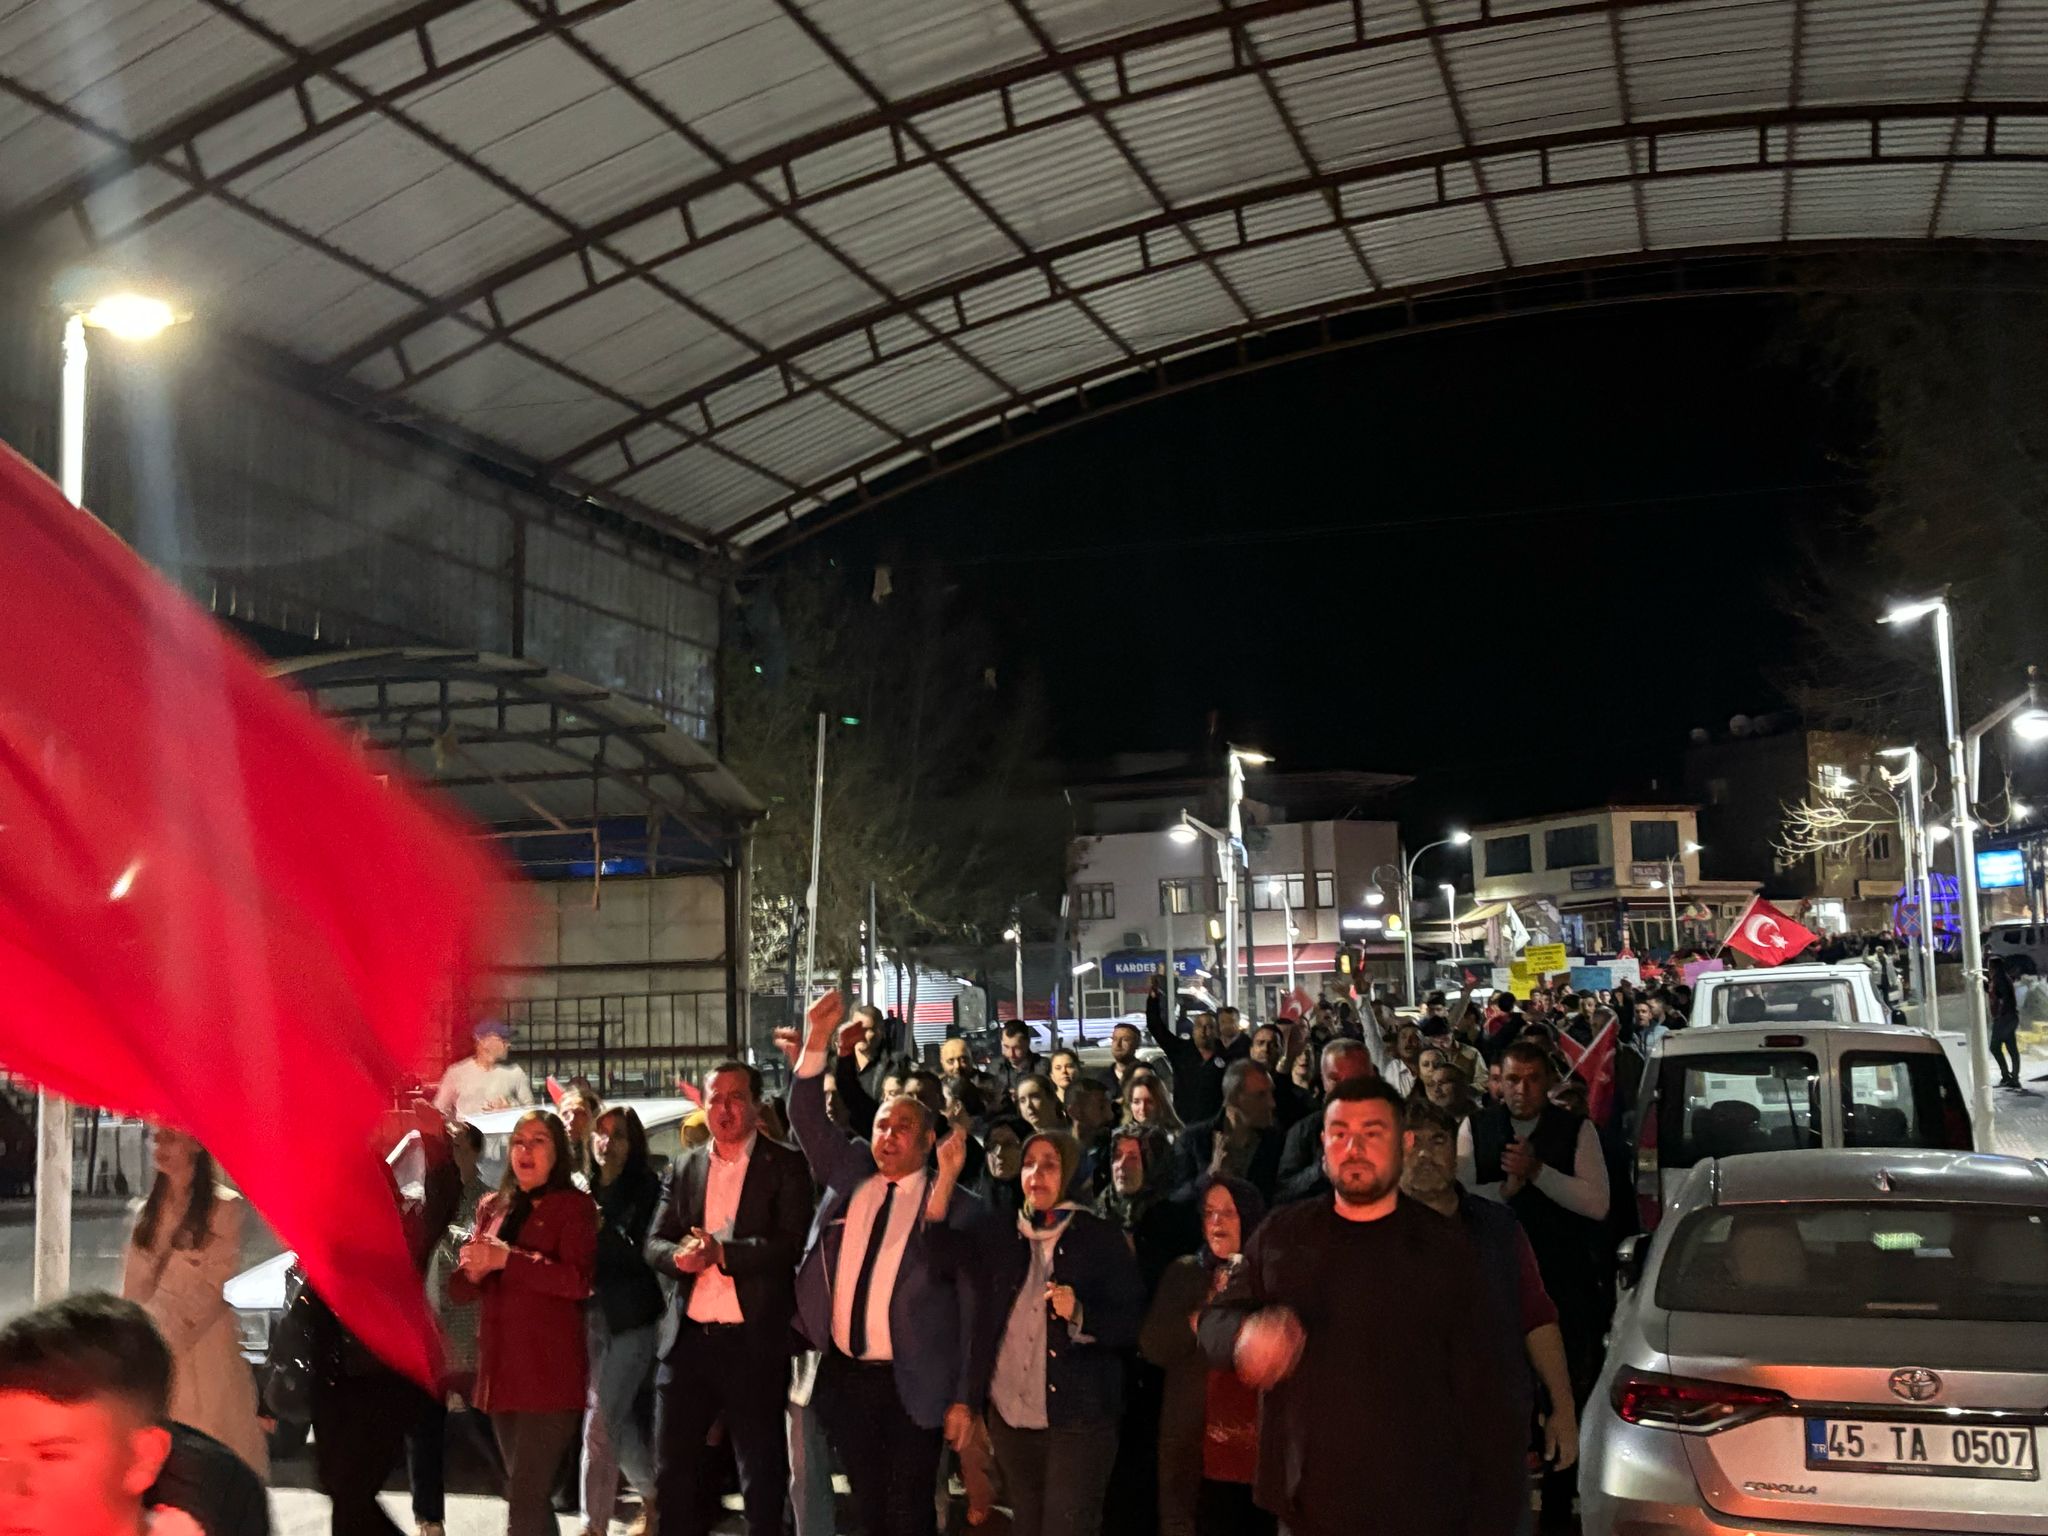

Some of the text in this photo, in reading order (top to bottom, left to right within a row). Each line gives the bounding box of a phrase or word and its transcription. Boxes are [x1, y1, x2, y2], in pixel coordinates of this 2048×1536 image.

[1811, 1443, 1827, 1454] TR
[1827, 1422, 2030, 1467] 45 TA 0507
